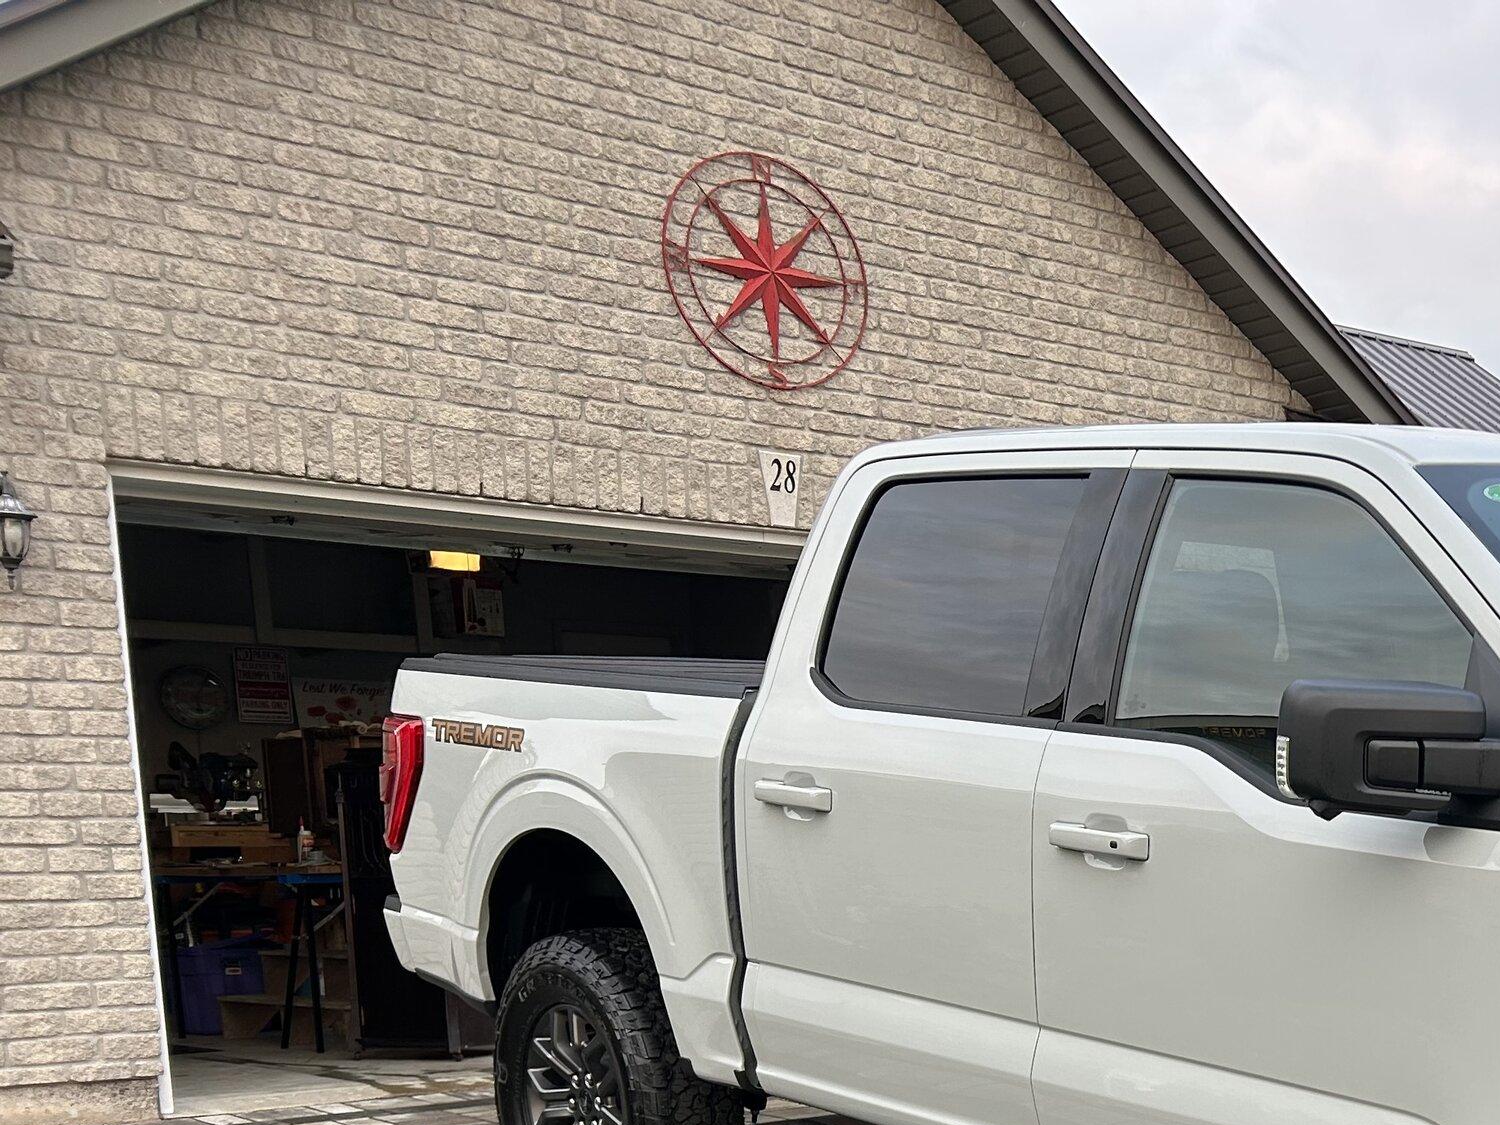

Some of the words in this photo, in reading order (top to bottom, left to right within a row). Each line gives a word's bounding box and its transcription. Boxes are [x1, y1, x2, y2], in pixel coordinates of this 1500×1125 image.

[770, 458, 797, 493] 28
[302, 682, 325, 694] Lest
[329, 683, 346, 694] We
[272, 701, 287, 710] ONLY
[432, 718, 525, 753] TREMOR
